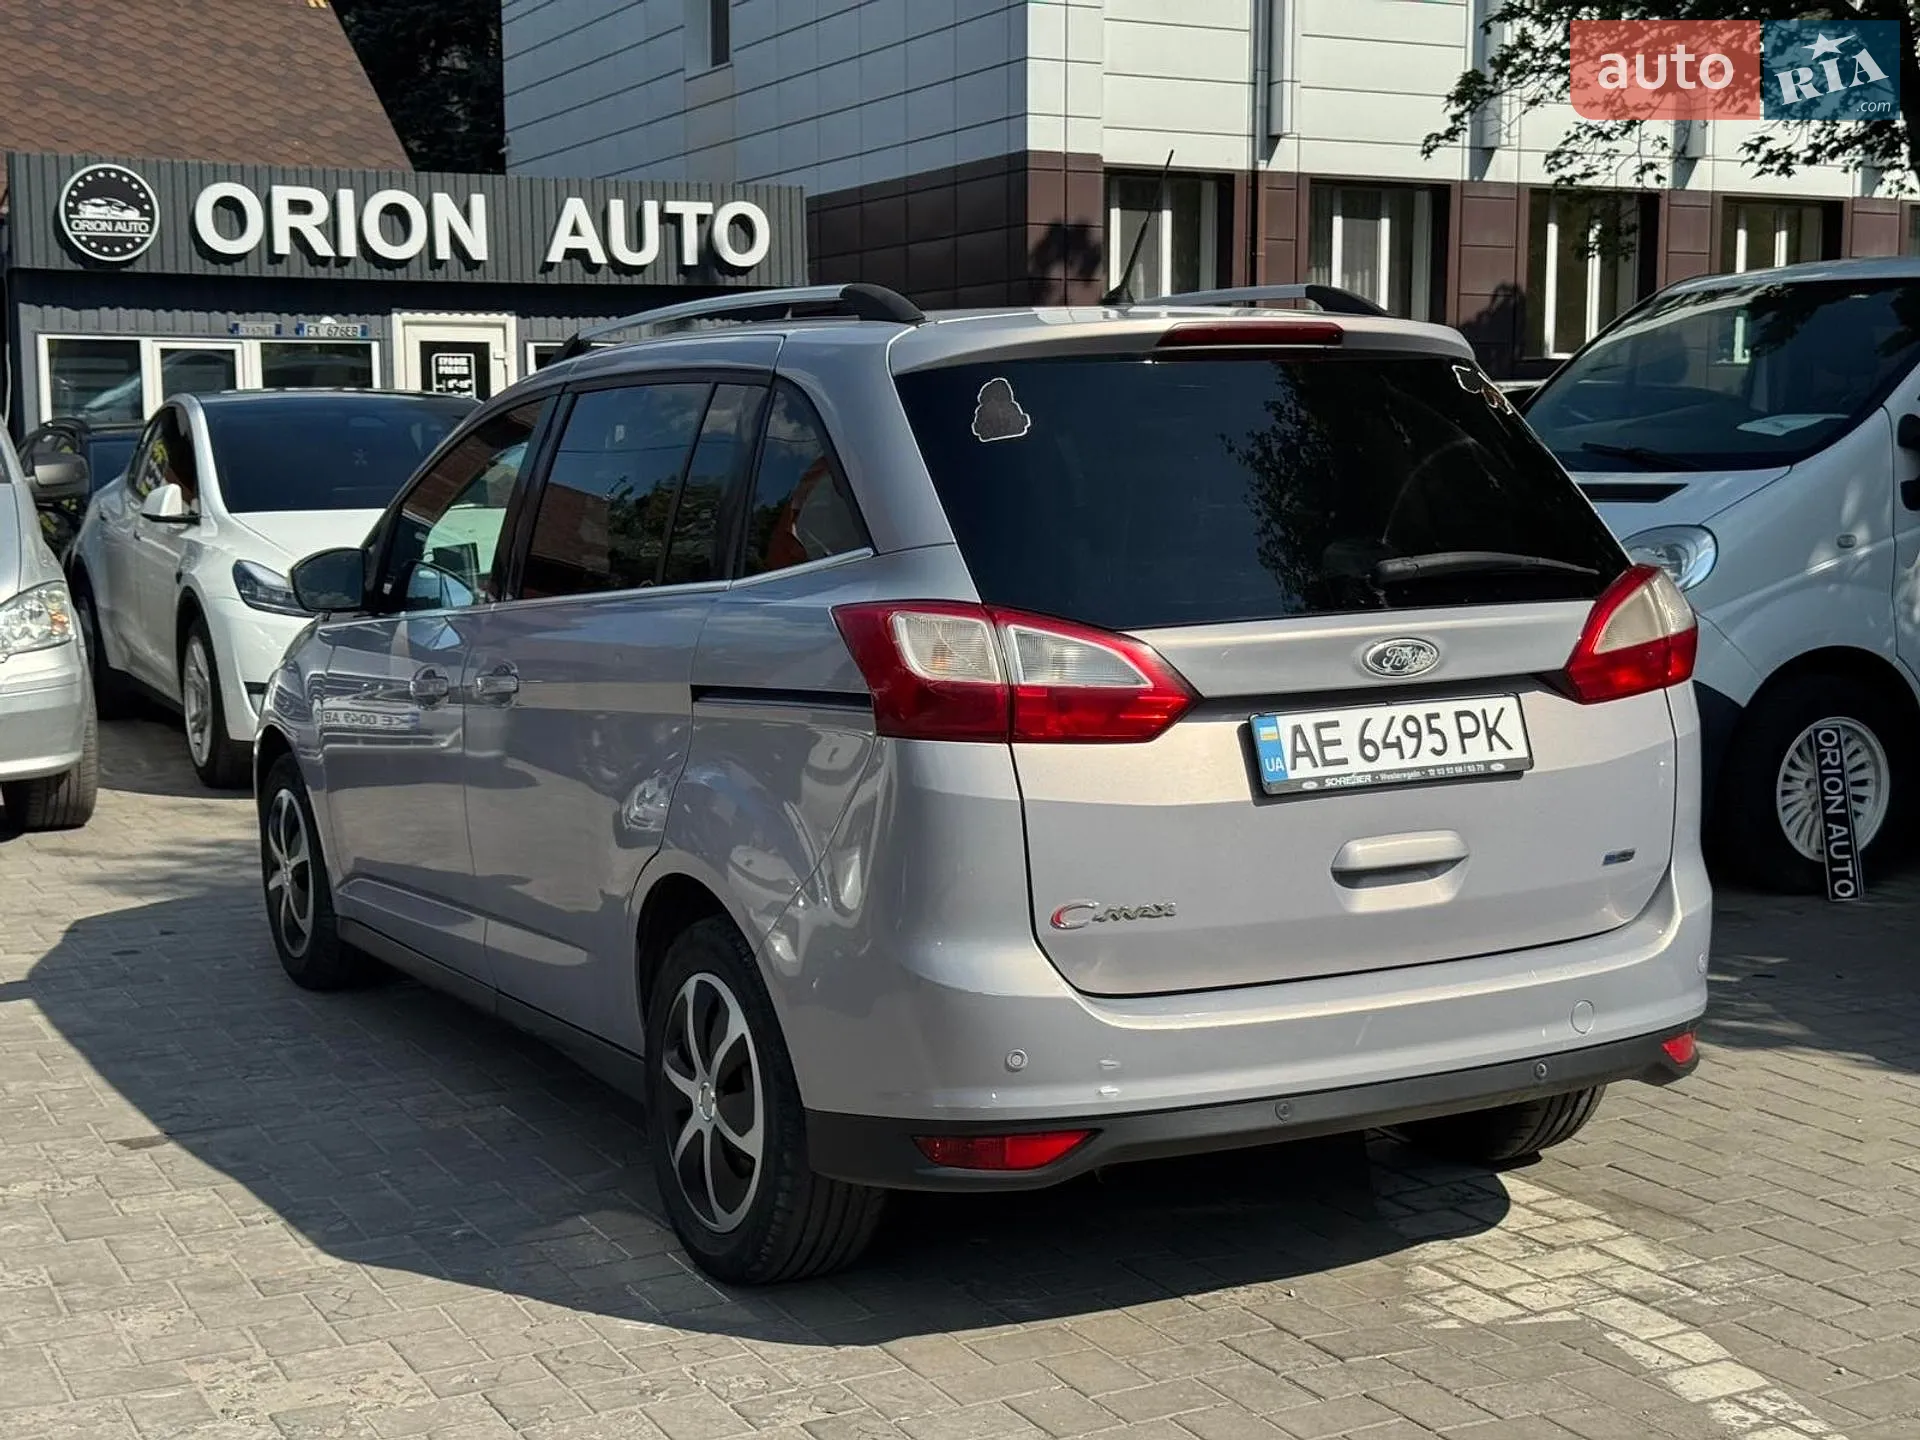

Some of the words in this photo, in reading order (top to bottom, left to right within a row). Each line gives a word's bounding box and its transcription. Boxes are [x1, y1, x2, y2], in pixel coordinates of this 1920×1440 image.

[71, 219, 112, 232] ORION
[114, 222, 149, 233] AUTO
[194, 181, 488, 262] ORION
[546, 197, 771, 268] AUTO
[1265, 757, 1285, 772] UA
[1290, 720, 1348, 771] AE
[1358, 712, 1449, 763] 6495
[1454, 707, 1514, 755] PK
[1816, 729, 1847, 815] ORION
[1827, 823, 1854, 898] AUTO
